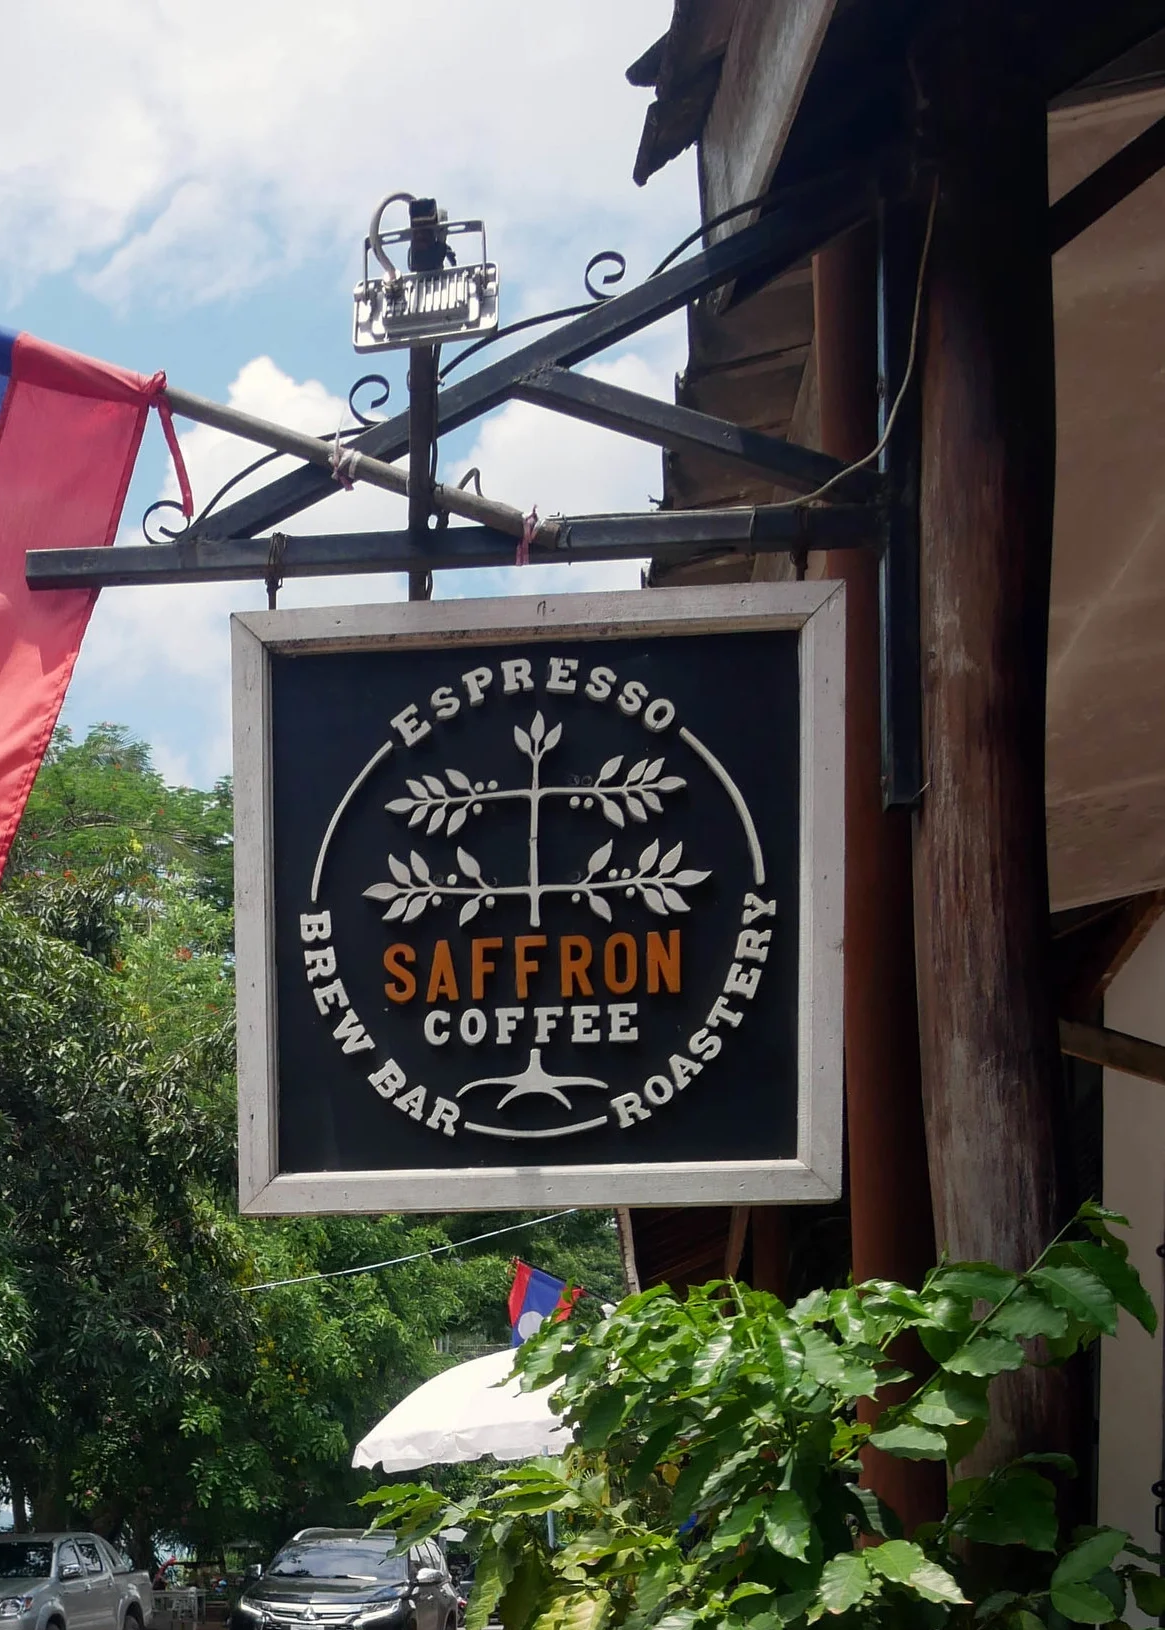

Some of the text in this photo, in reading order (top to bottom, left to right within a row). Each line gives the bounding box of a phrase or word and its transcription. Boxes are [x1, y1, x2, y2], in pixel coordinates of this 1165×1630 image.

[390, 656, 676, 748] ESPRESSO
[382, 929, 682, 1006] SAFFRON
[609, 891, 777, 1130] ROASTERY
[299, 910, 462, 1138] BREW BAR
[423, 1002, 639, 1047] COFFEE
